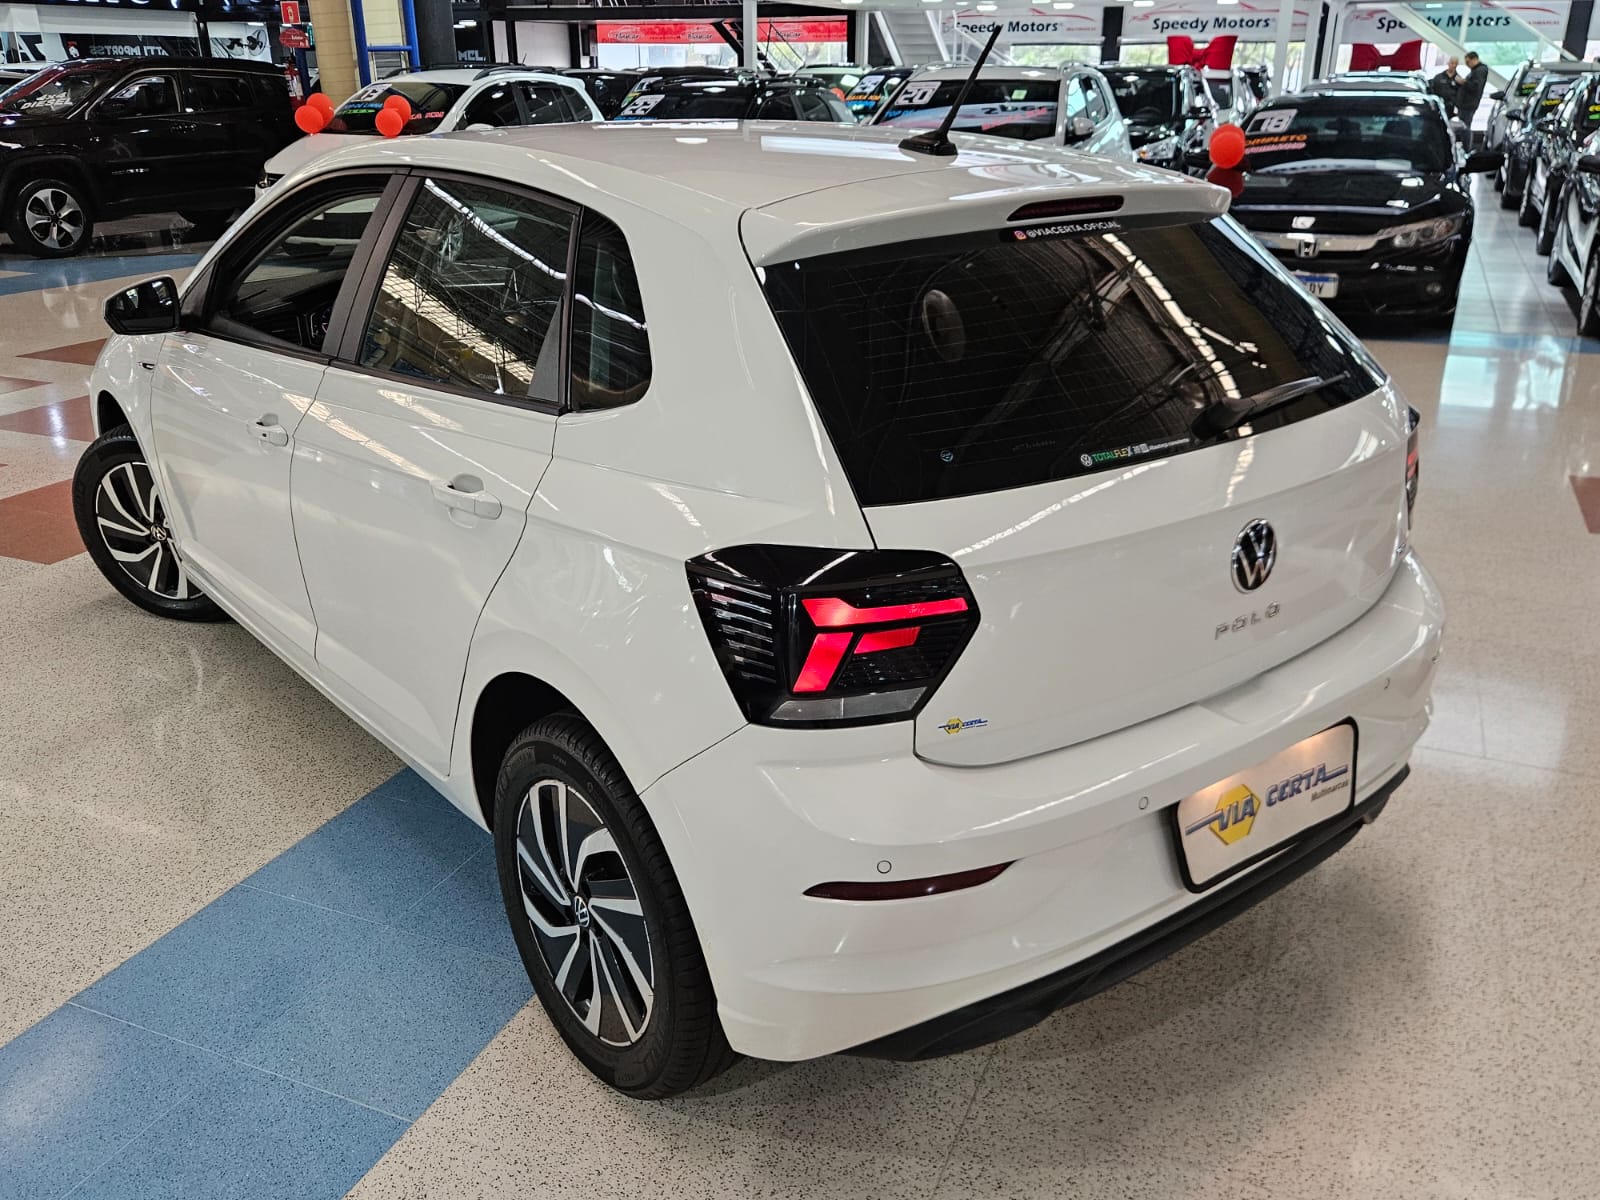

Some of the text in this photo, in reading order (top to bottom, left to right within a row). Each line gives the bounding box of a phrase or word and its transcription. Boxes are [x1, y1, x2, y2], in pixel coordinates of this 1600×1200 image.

[1008, 20, 1058, 32] Motors
[1152, 18, 1270, 33] Speedy Motors
[20, 98, 73, 109] DIESEL
[1215, 601, 1280, 640] POLO
[1214, 762, 1328, 832] VIA CERTA
